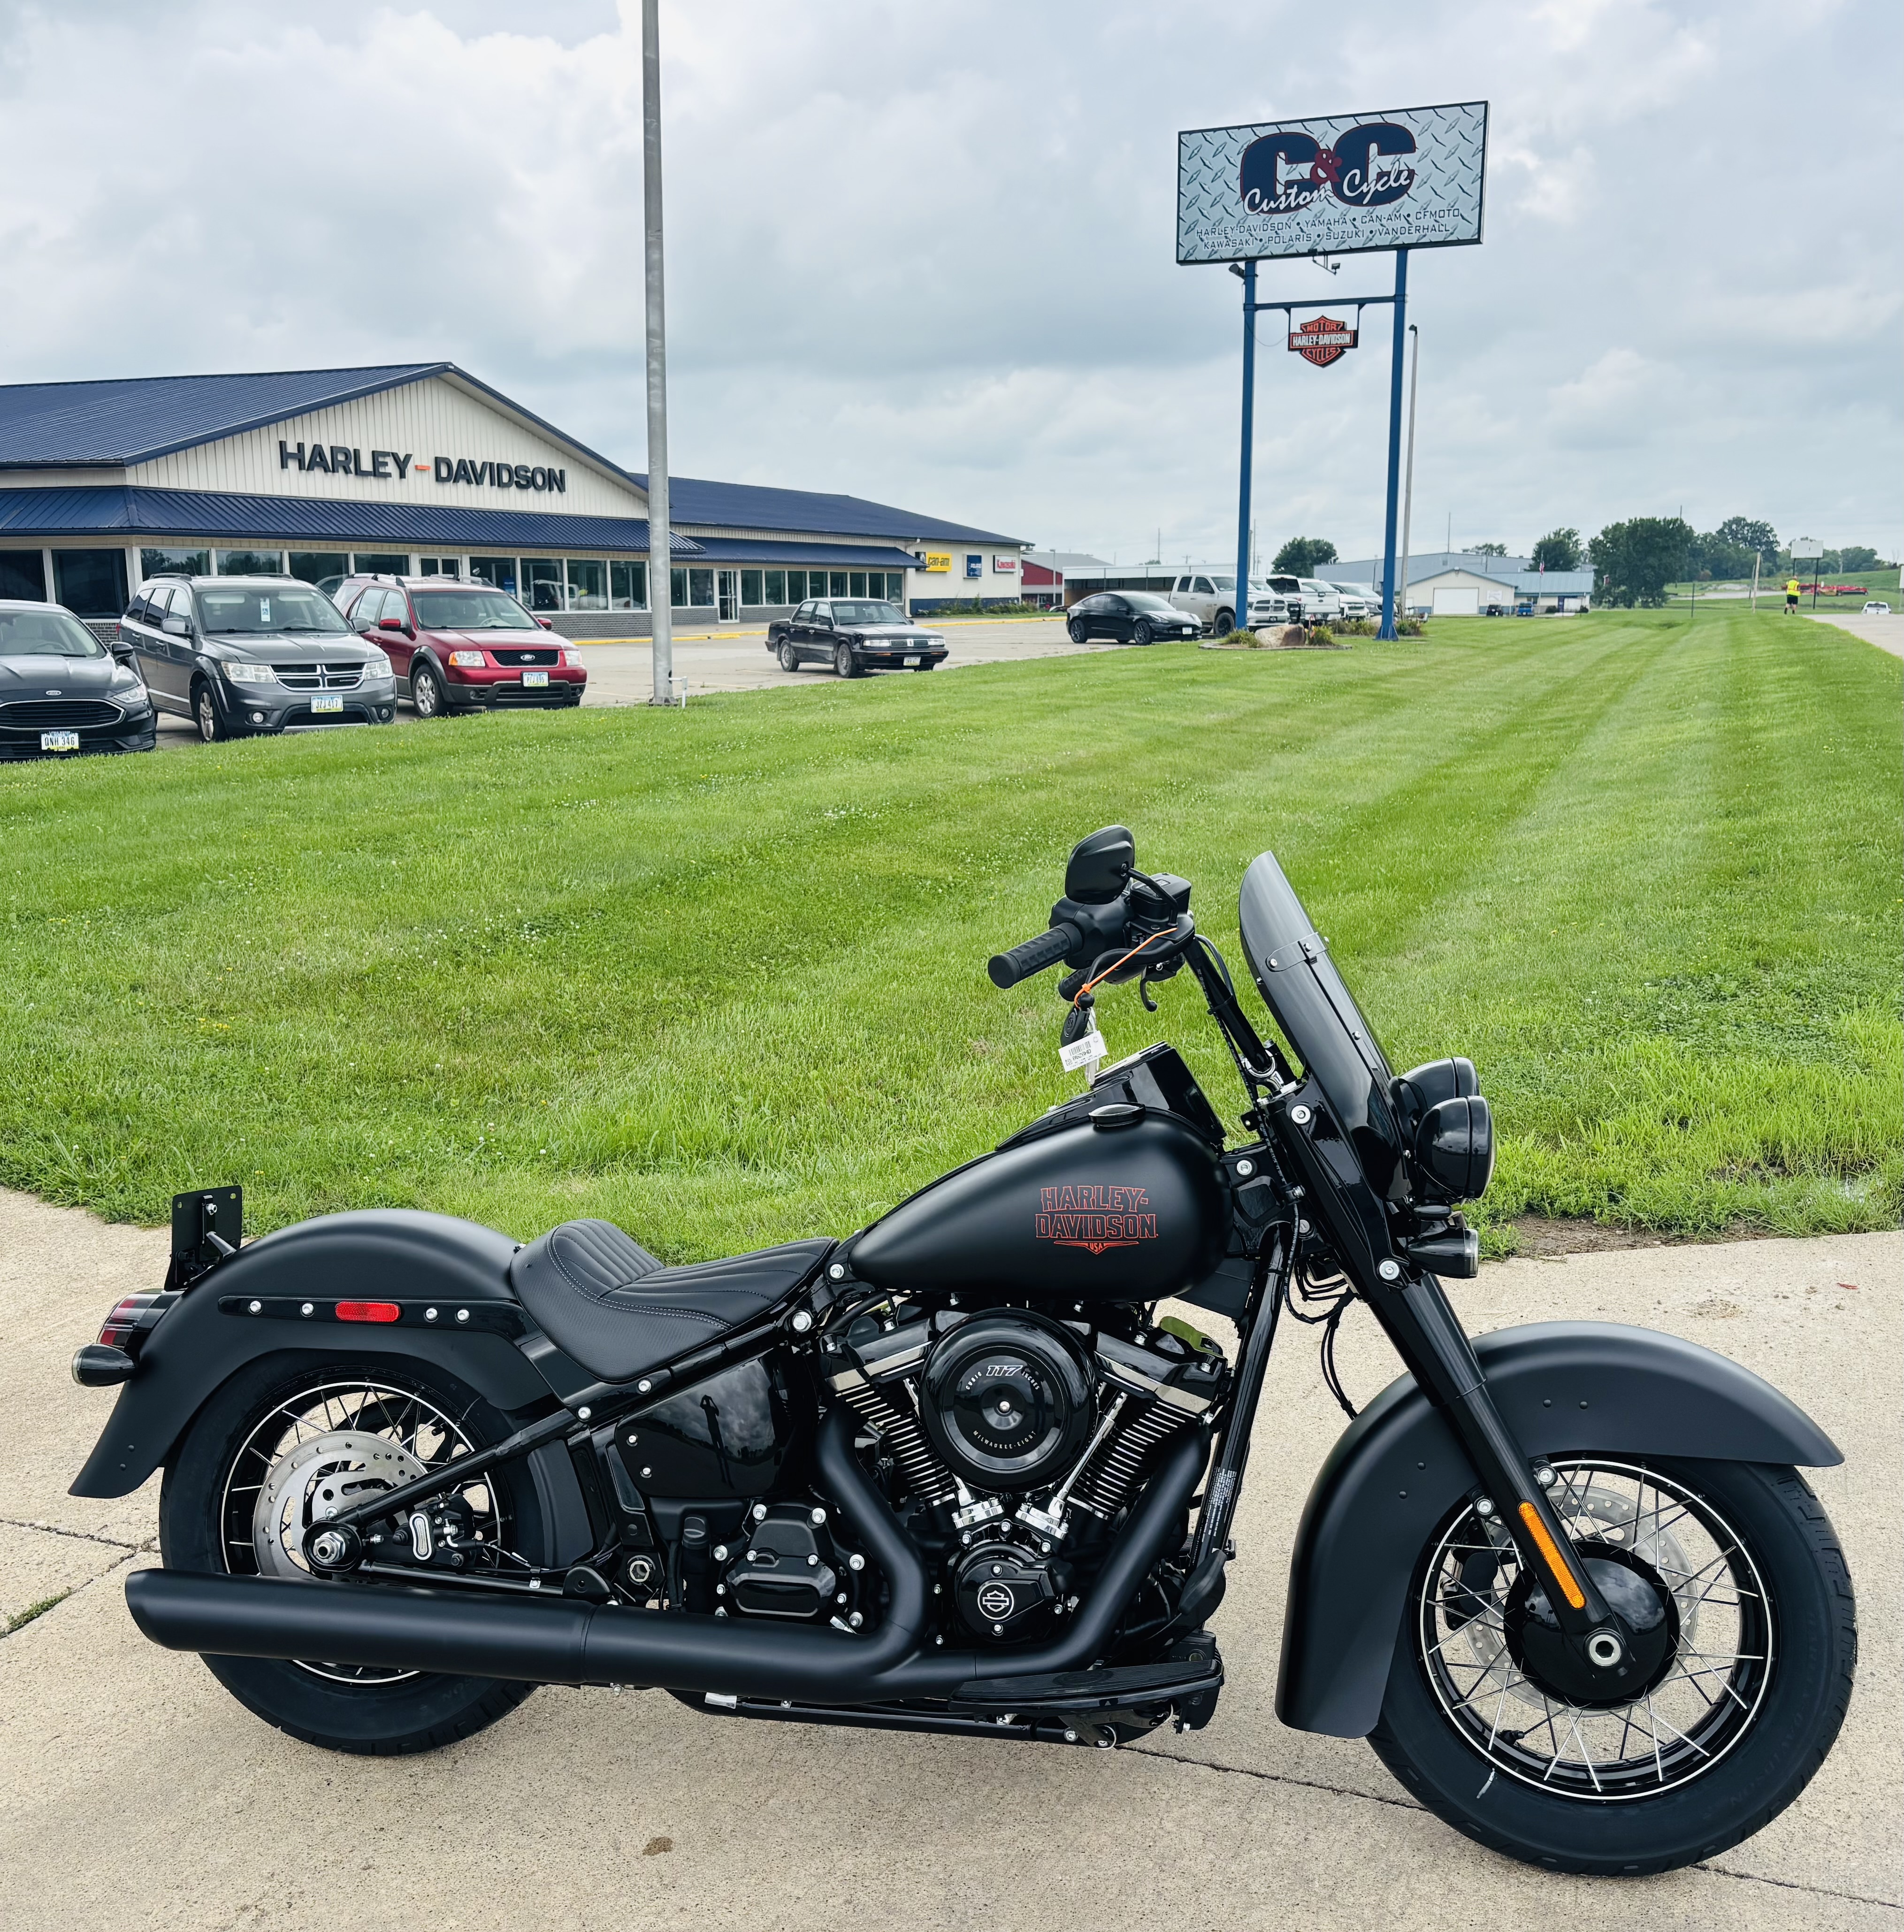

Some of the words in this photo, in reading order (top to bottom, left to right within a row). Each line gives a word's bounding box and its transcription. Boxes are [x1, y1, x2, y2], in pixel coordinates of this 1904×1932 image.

[1243, 183, 1334, 215] Custom
[1343, 161, 1410, 205] Cycle
[1196, 222, 1292, 237] HARLEY-DAVIDSON
[1305, 217, 1347, 228] YAMAHA
[1361, 213, 1401, 224] CAN-AM
[1415, 208, 1460, 220] CFMOTO
[1204, 238, 1254, 250] KAWASAKI
[1268, 233, 1312, 245] POLARIS
[1325, 229, 1364, 240] SUZUKI
[1377, 223, 1450, 237] VANDERHALL
[1307, 320, 1337, 332] MOTOR
[1292, 333, 1351, 346] HARLEY-DAVIDSON
[1306, 347, 1337, 362] CYCLES
[279, 440, 566, 493] HARLEY-DAVIDSON
[62, 736, 75, 746] 346
[1089, 1242, 1103, 1252] USA
[965, 1371, 982, 1390] CUBIC
[986, 1365, 1024, 1376] 117
[1021, 1371, 1040, 1390] INCHES
